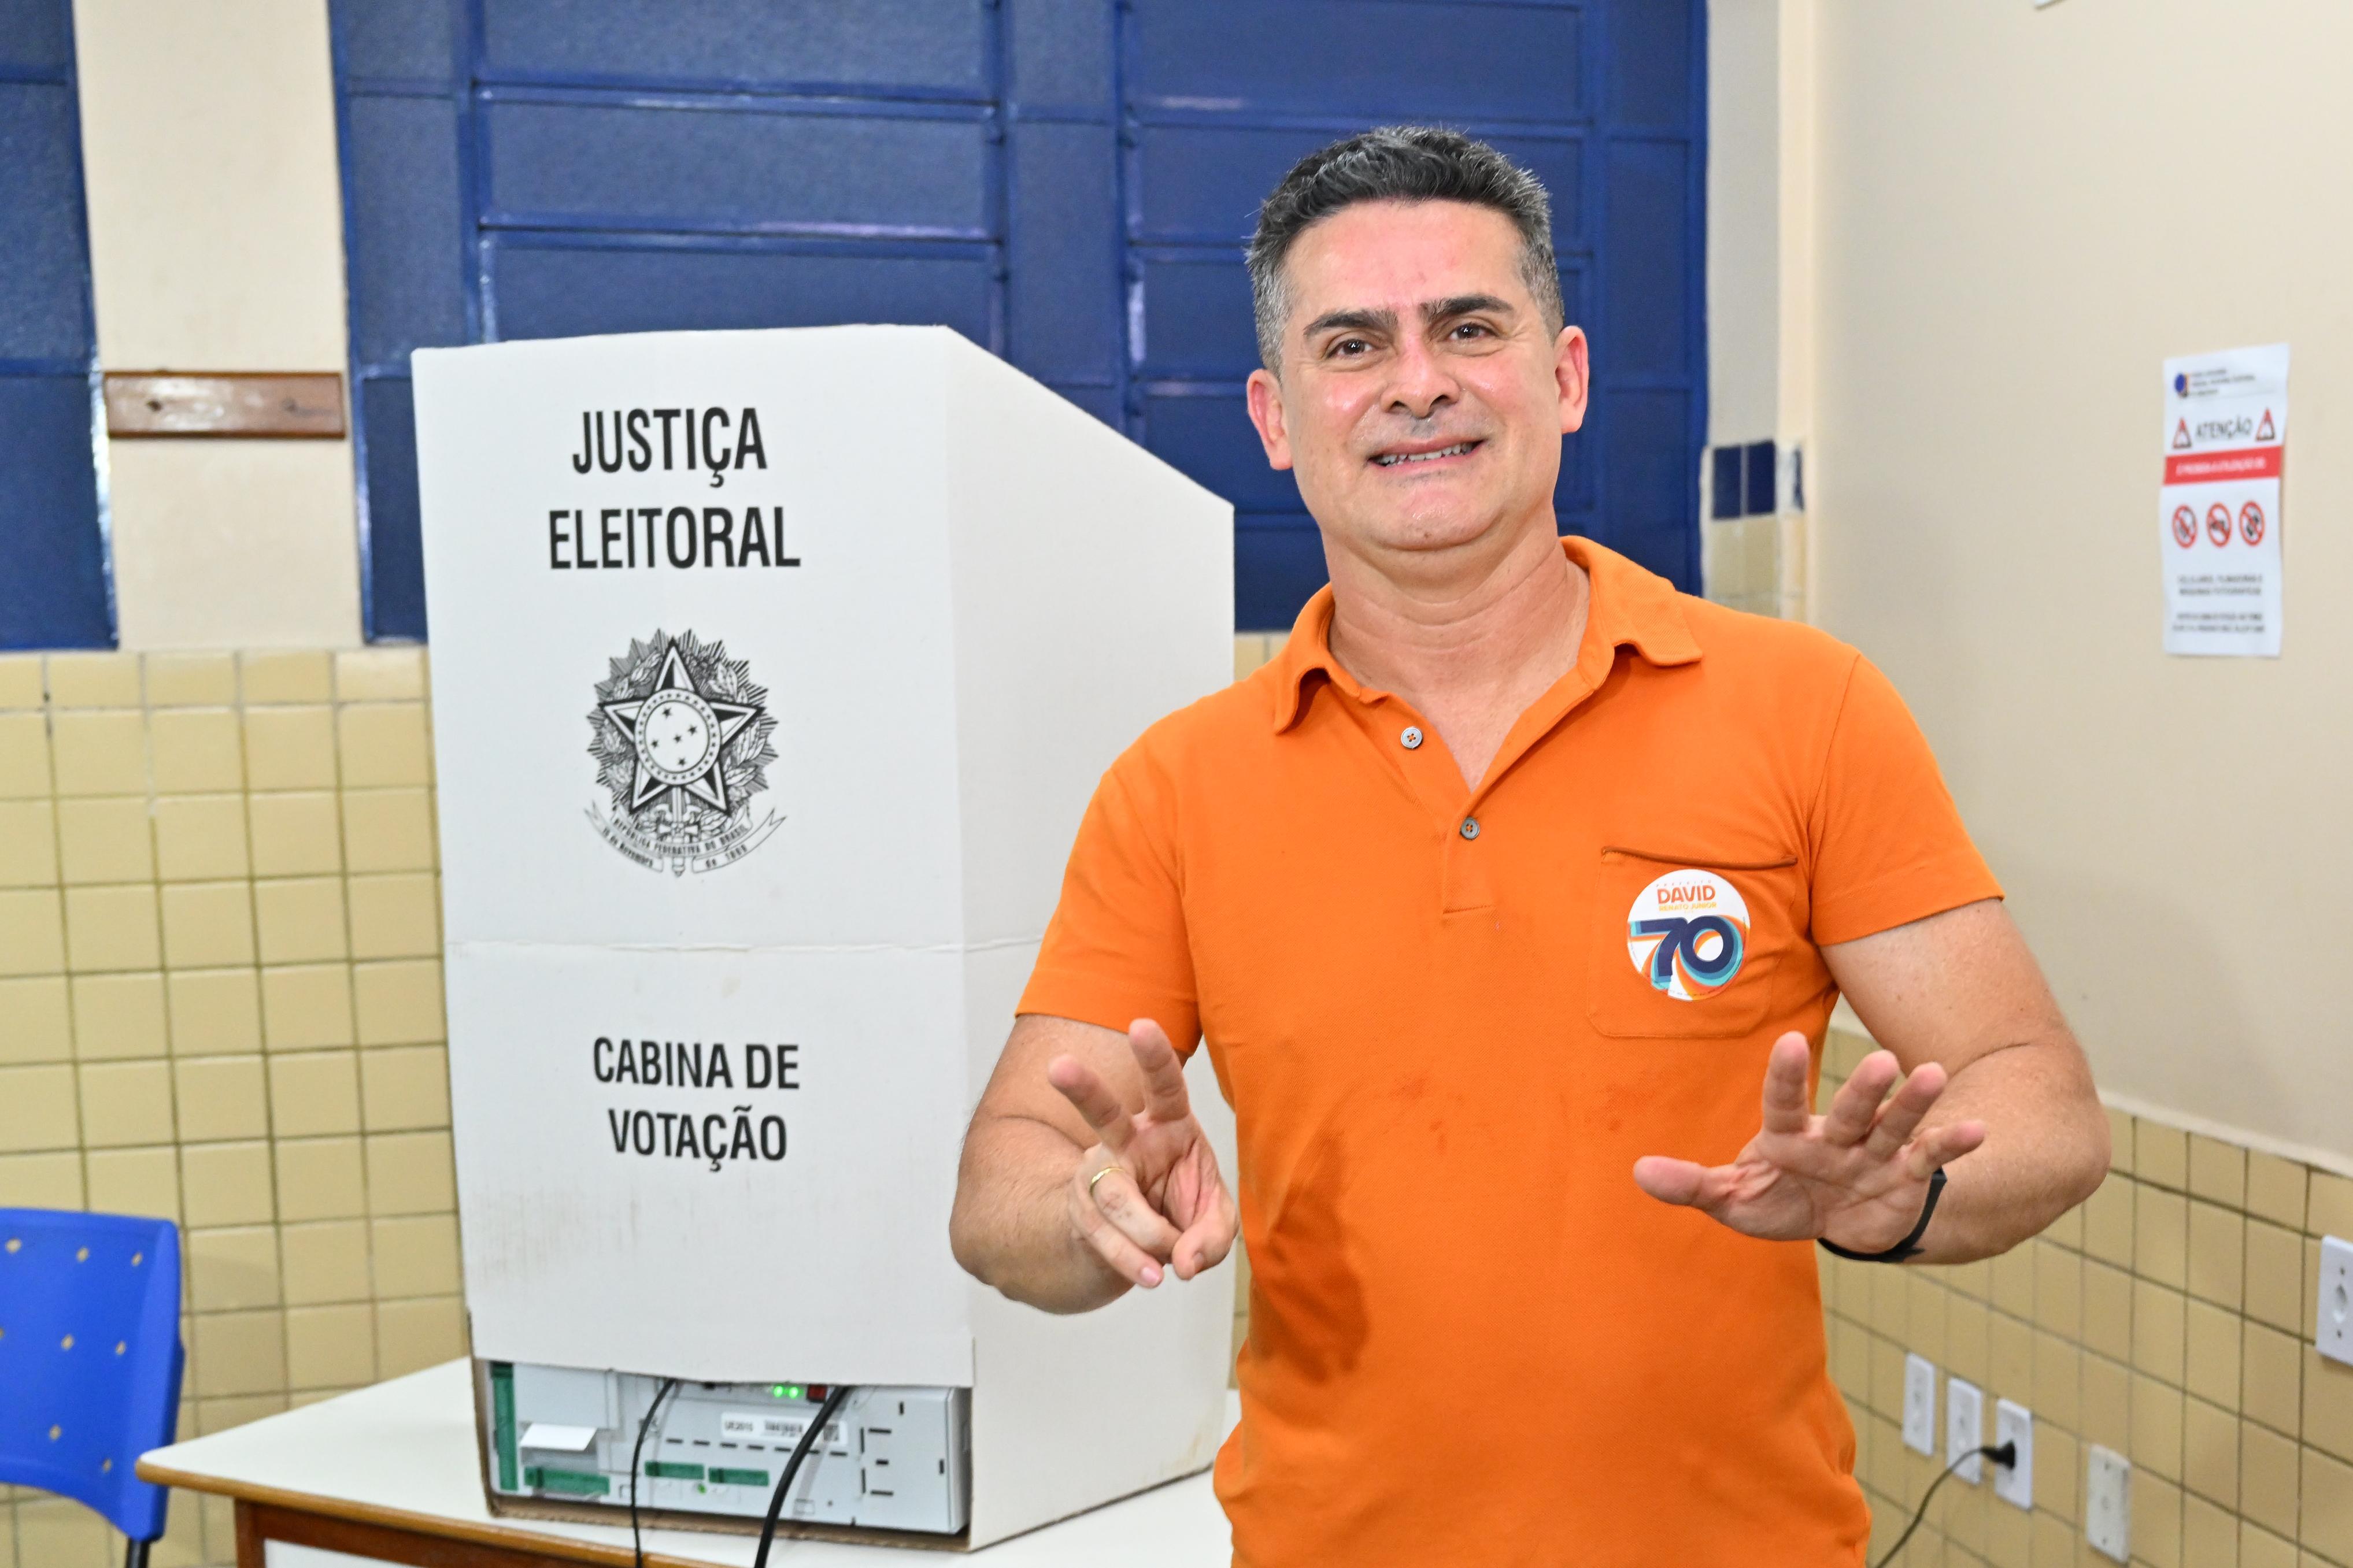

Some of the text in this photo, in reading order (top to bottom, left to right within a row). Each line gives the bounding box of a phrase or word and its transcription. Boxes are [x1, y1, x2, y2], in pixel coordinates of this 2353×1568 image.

[572, 406, 768, 488] JUSTIÇA
[2196, 414, 2253, 439] ATENÇÃO
[549, 506, 802, 569] ELEITORAL
[1657, 885, 1716, 905] DAVID
[1659, 903, 1689, 911] RENATO
[1638, 915, 1737, 980] 70
[593, 1036, 800, 1089] CABINA DE
[608, 1104, 787, 1173] VOTAÇÃO
